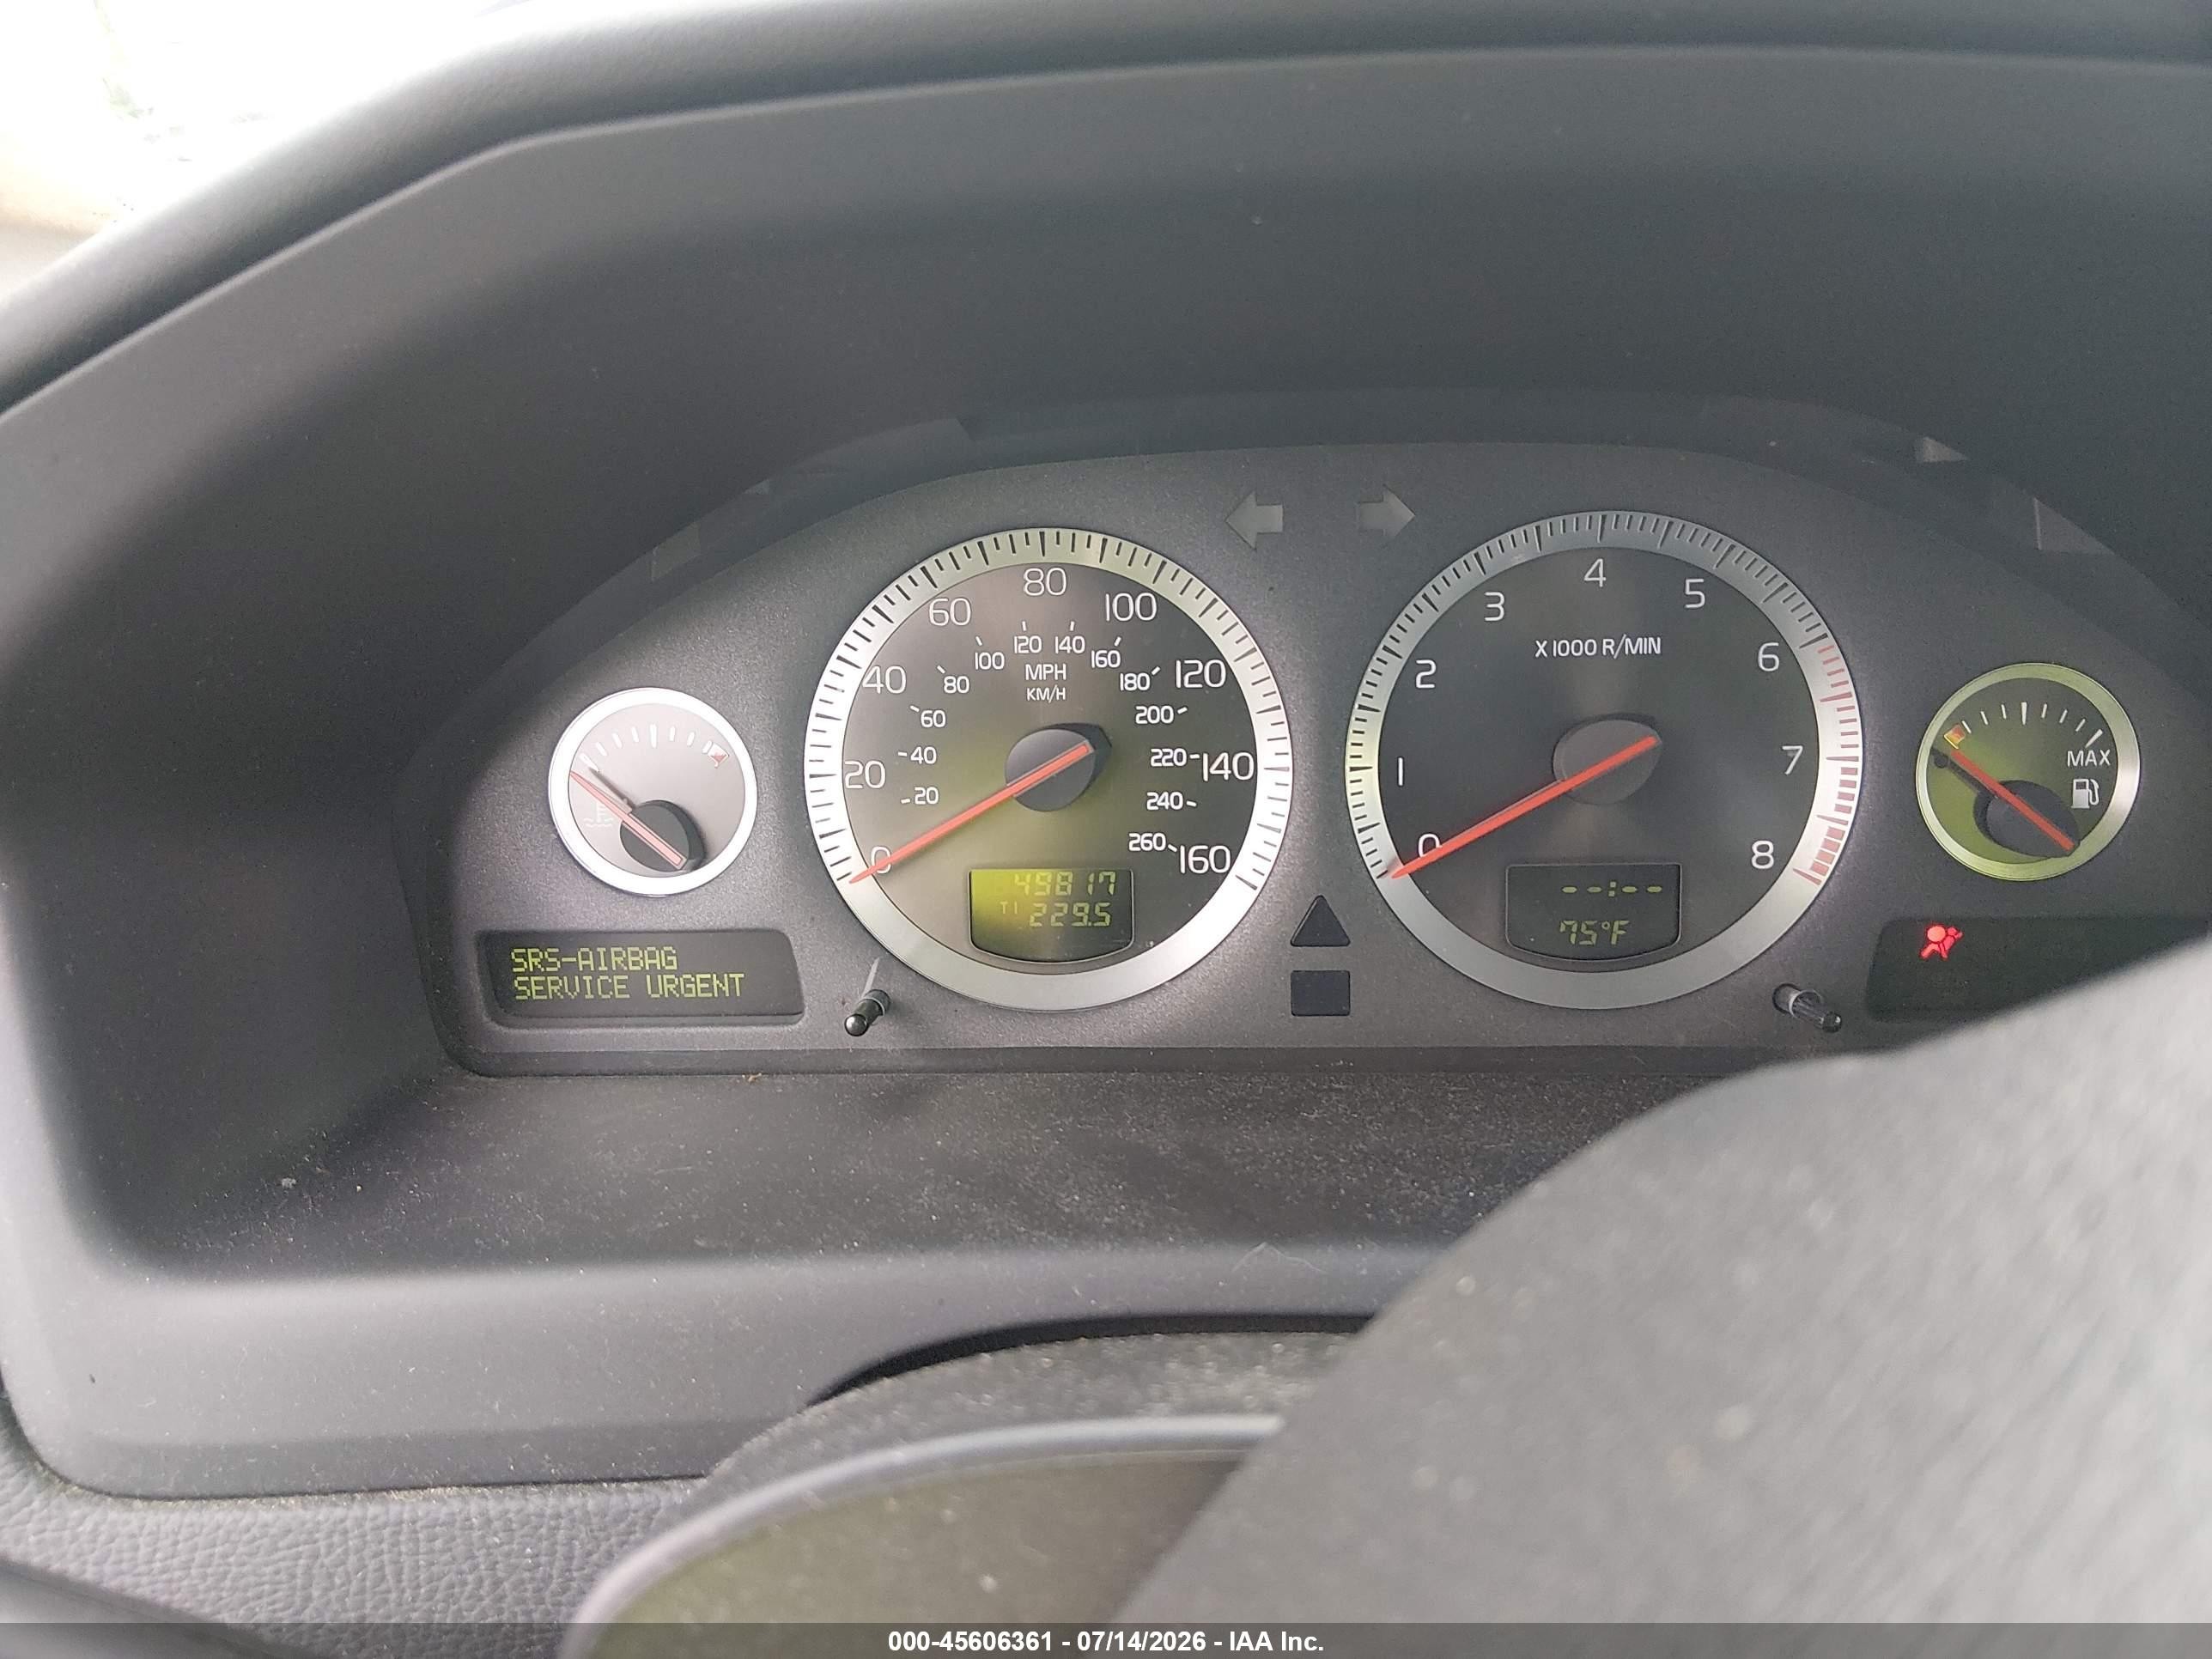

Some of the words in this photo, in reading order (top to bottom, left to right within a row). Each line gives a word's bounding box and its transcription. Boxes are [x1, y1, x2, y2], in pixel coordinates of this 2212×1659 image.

[1023, 567, 1066, 596] 80
[1583, 558, 1606, 586] 4
[1685, 578, 1705, 608] 5
[928, 598, 971, 626] 60
[1105, 592, 1157, 622] 100
[1484, 592, 1504, 621] 3
[1013, 635, 1042, 653] 120
[1054, 635, 1085, 653] 140
[1534, 640, 1548, 658] X
[1553, 638, 1597, 657] 1000
[1602, 634, 1662, 659] R/MIN
[1758, 641, 1780, 672] 6
[975, 652, 1005, 670] 100
[1091, 650, 1121, 668] 160
[862, 665, 907, 694] 40
[944, 676, 969, 694] 80
[1025, 664, 1066, 681] MPH
[1120, 672, 1150, 691] 180
[1176, 659, 1226, 688] 120
[1415, 659, 1437, 689] 2
[1026, 685, 1066, 702] KM/H
[921, 711, 946, 728] 60
[1135, 706, 1174, 724] 200
[910, 747, 937, 764] 40
[1151, 749, 1187, 767] 220
[1202, 752, 1254, 781] 140
[1782, 745, 1804, 775] 7
[2067, 749, 2111, 767] MAX
[844, 761, 886, 789] 20
[1398, 757, 1403, 786] 1
[914, 787, 939, 805] 20
[1146, 792, 1183, 810] 240
[1128, 833, 1166, 851] 260
[1752, 839, 1775, 870] 8
[871, 846, 892, 874] 0
[1180, 845, 1231, 874] 160
[1030, 902, 1111, 927] 229.5
[1559, 920, 1630, 945] 75°F
[511, 946, 678, 972] SRS-AIRBAG
[514, 975, 630, 1000] SERVICE
[646, 973, 745, 998] URGENT
